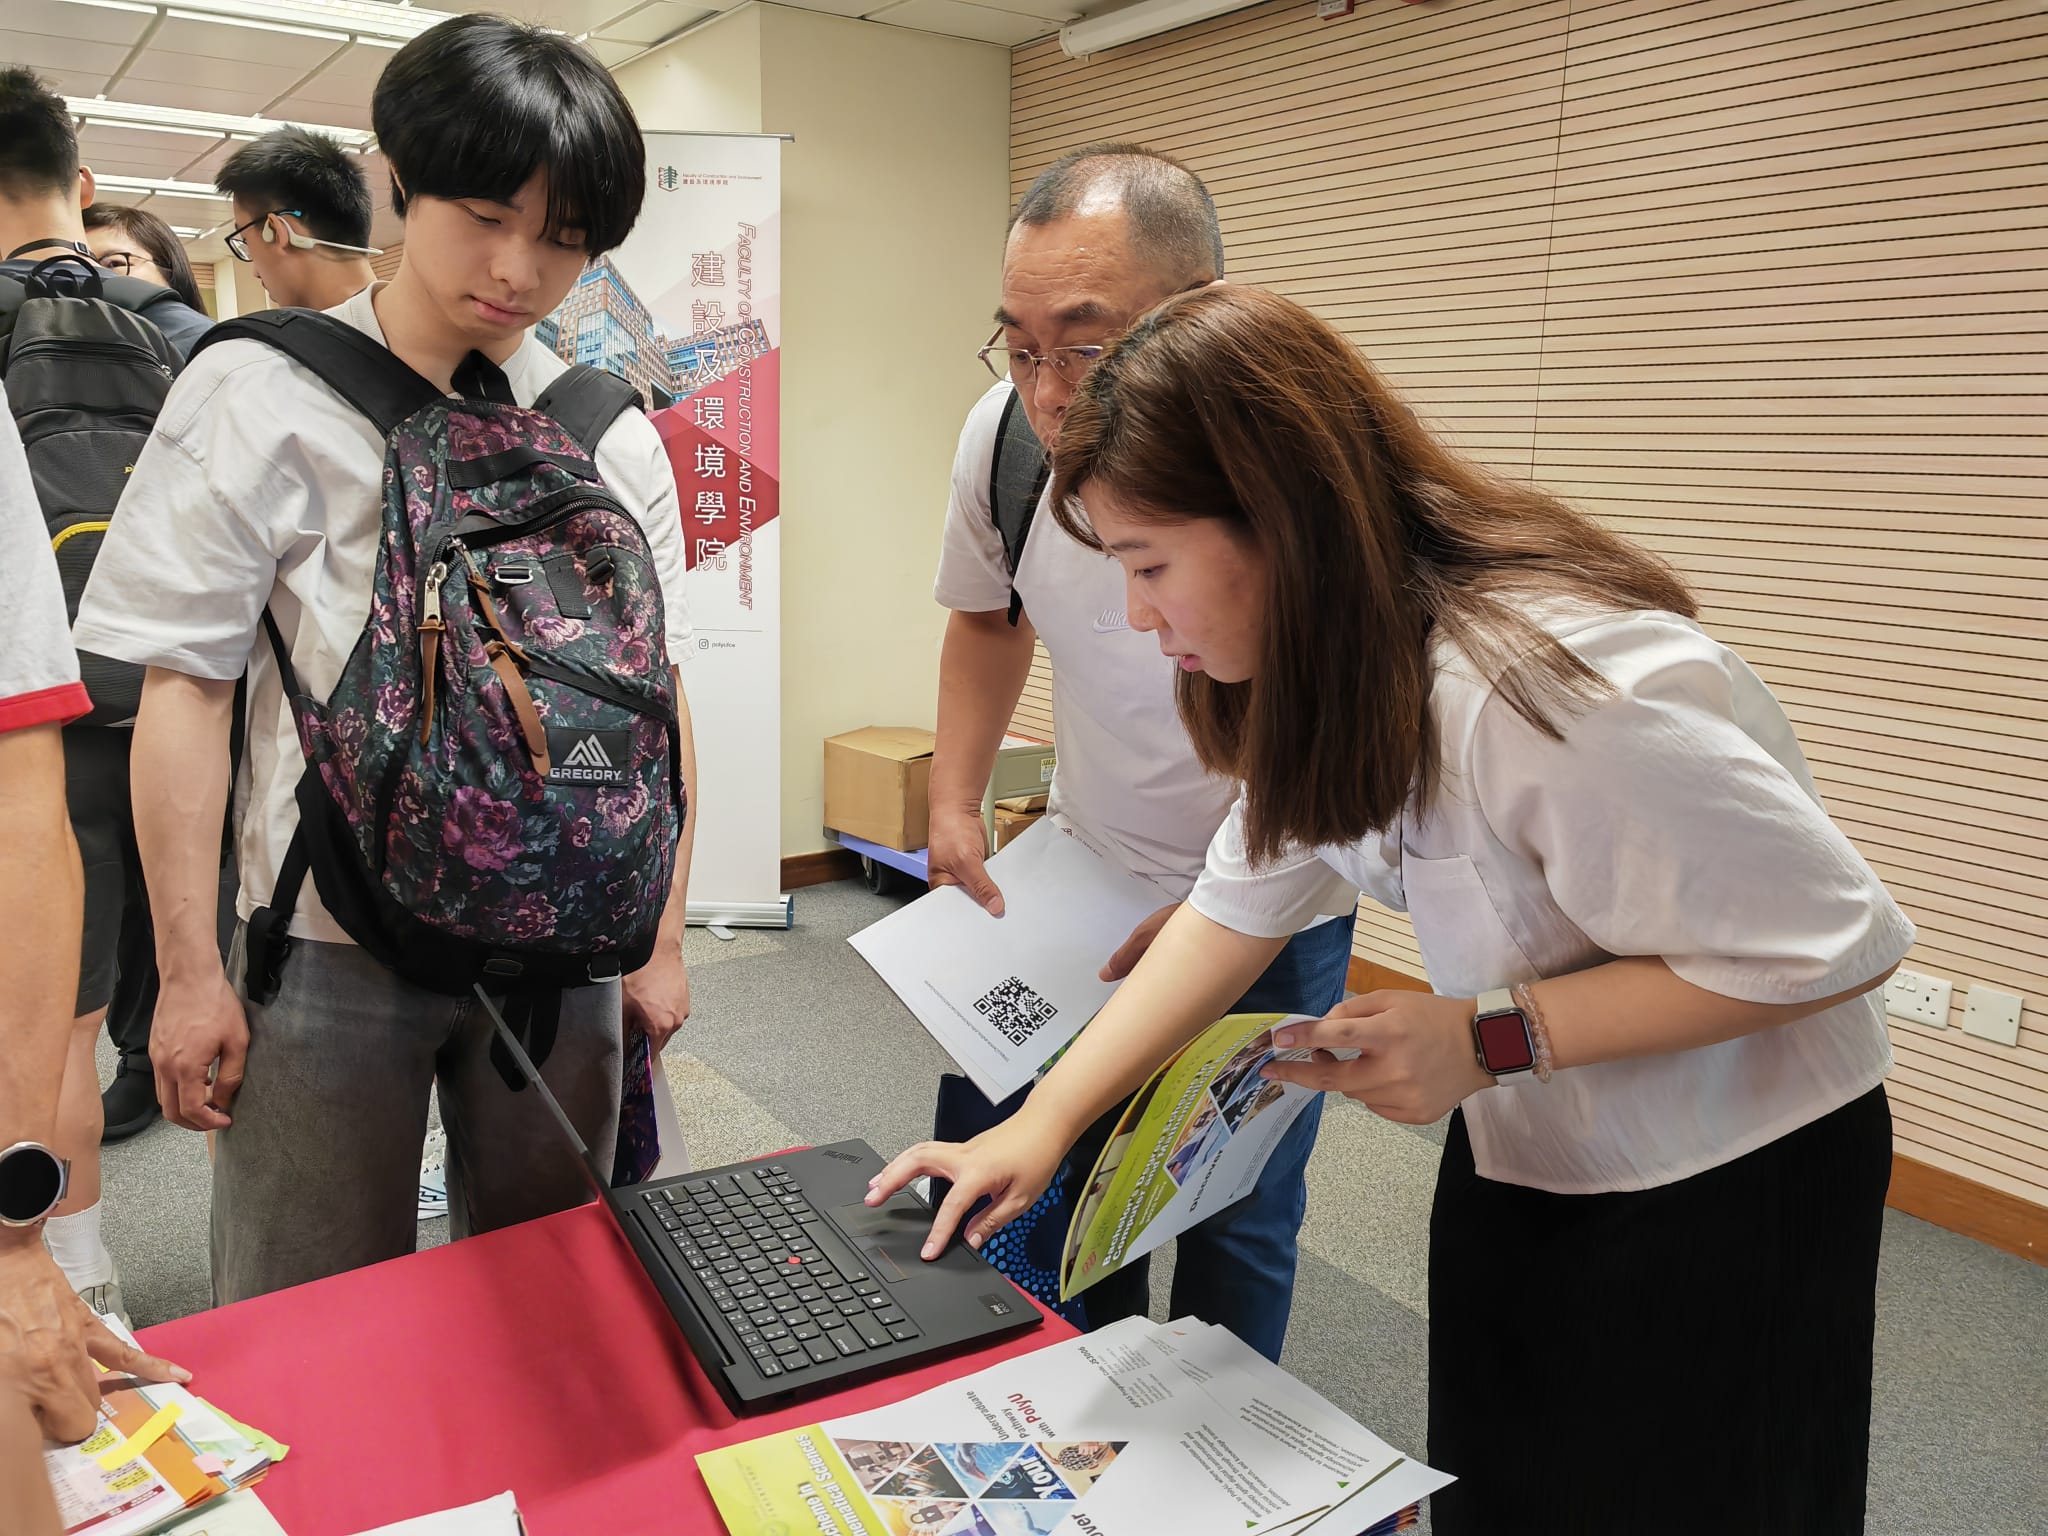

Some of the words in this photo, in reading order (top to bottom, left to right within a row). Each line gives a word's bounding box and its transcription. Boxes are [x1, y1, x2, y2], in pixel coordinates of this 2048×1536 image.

[691, 251, 727, 571] 建設及環境學院
[738, 328, 756, 456] CONSTRUCTION
[739, 458, 752, 493] AND
[739, 496, 756, 610] ENVIRONMENT
[1101, 608, 1127, 626] NIK
[550, 767, 622, 780] GREGORY
[1187, 1149, 1223, 1211] Discover
[1077, 1345, 1099, 1365] JS3006
[964, 1390, 1009, 1440] Undergraduate
[1000, 1409, 1029, 1438] Pathway
[1006, 1392, 1041, 1424] PolyU
[1038, 1421, 1055, 1438] with
[795, 1433, 832, 1482] Sciences
[1018, 1457, 1059, 1499] Your
